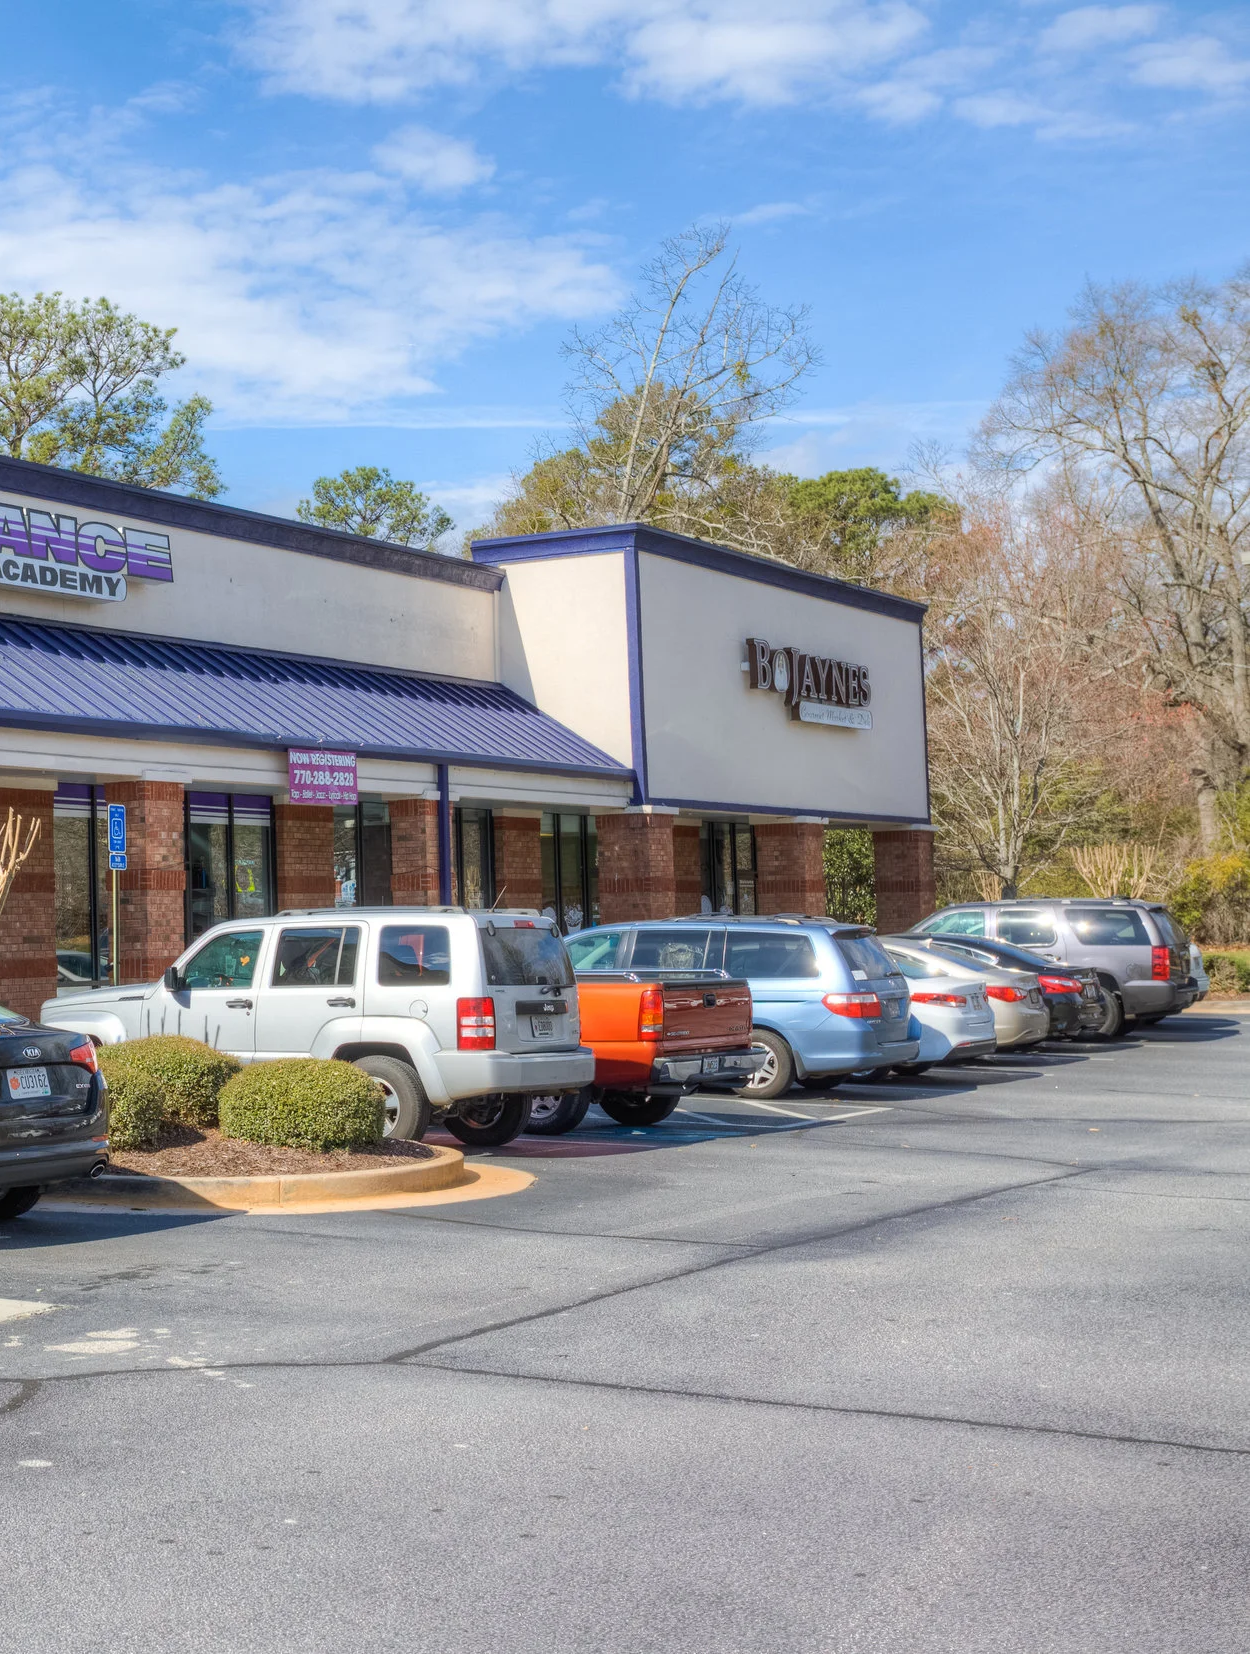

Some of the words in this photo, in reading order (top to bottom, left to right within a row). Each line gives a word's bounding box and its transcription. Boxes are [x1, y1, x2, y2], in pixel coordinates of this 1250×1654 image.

[290, 751, 309, 764] NOW
[311, 753, 355, 767] REGISTERING
[294, 769, 354, 786] 770-288-2828
[20, 1073, 49, 1090] CU3162
